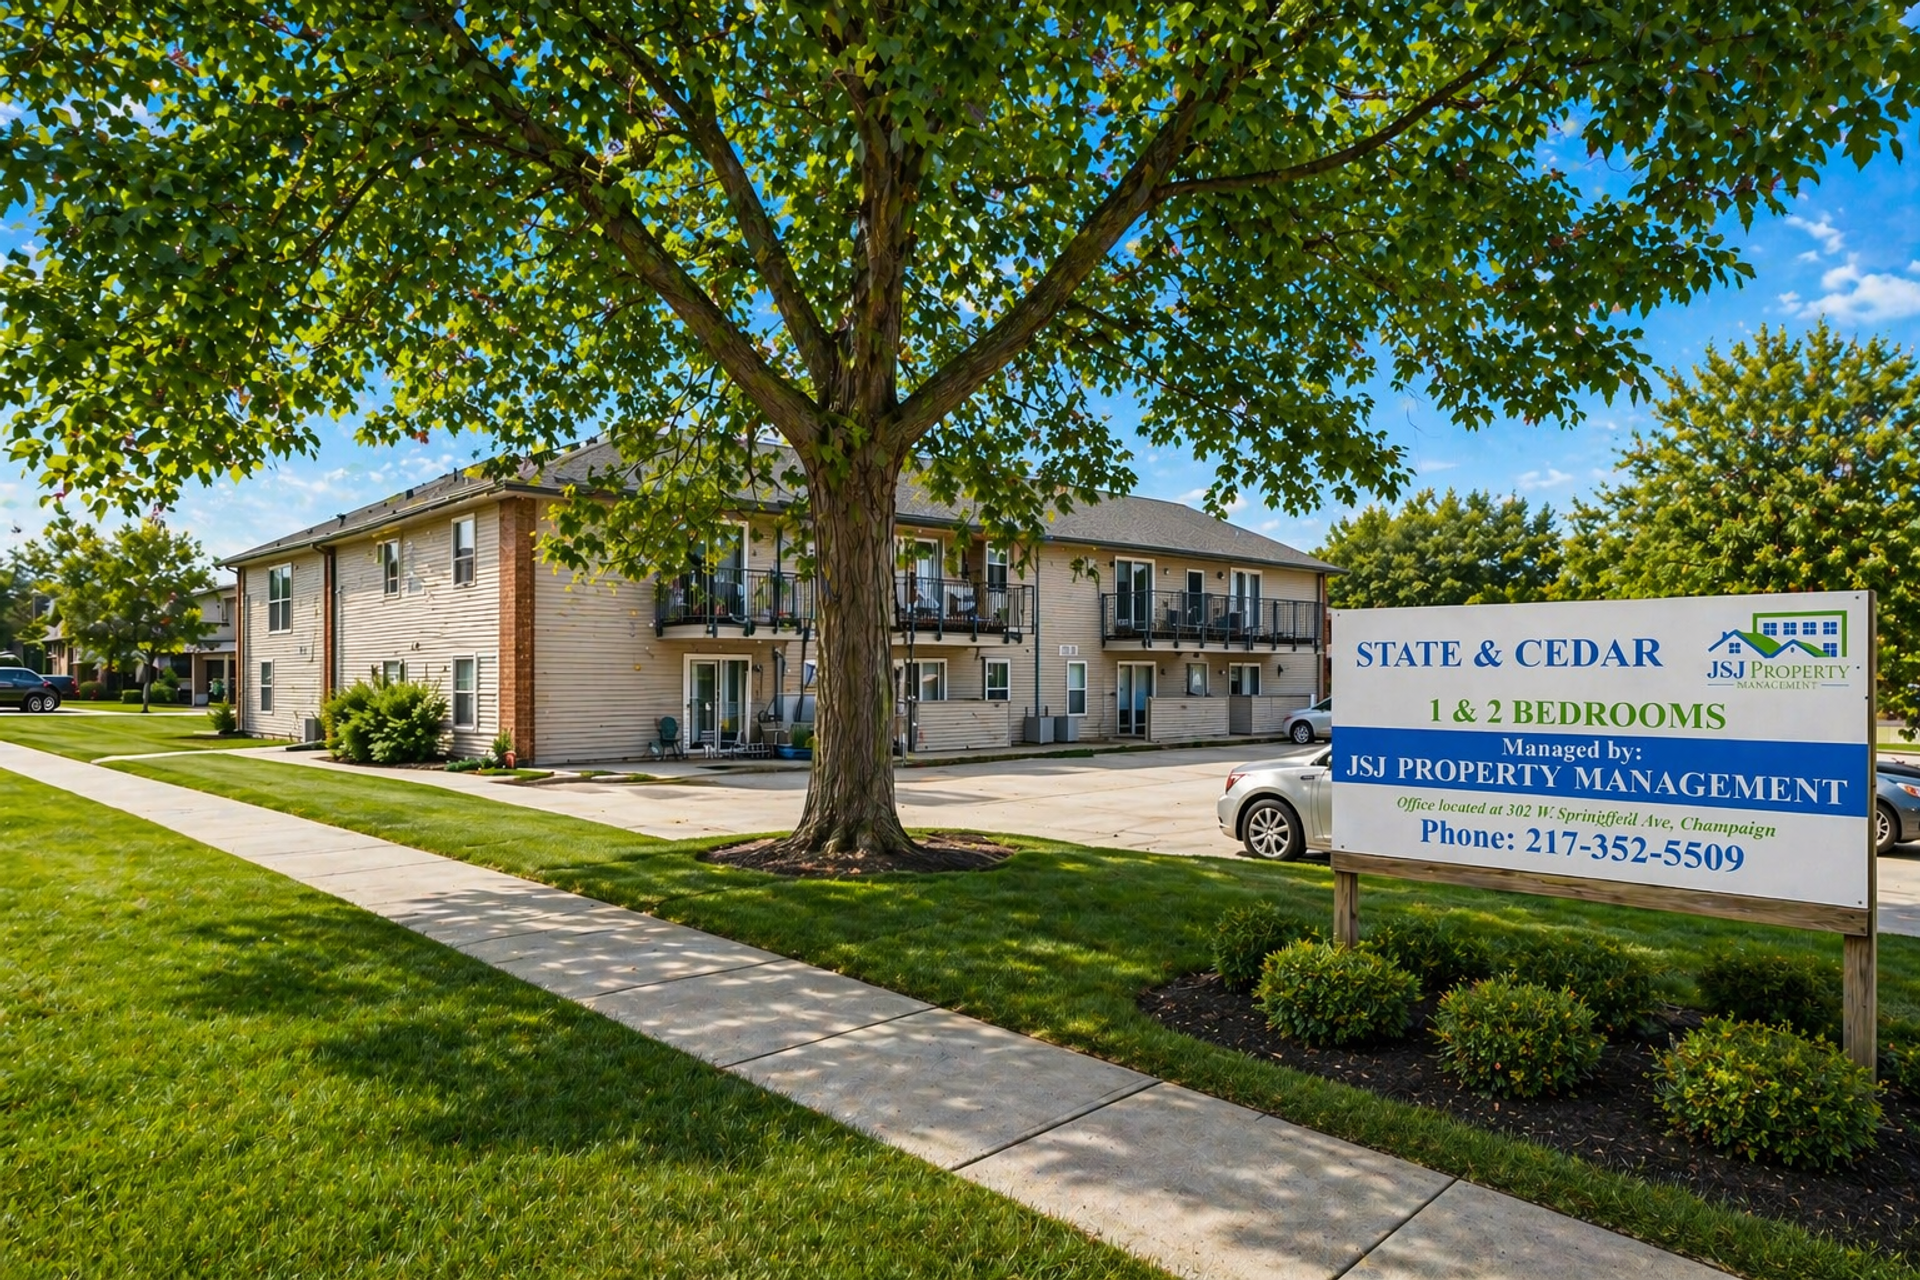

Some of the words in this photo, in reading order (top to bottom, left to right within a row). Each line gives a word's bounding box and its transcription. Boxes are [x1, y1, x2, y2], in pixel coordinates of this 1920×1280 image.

[1356, 640, 1461, 668] STATE
[1474, 640, 1502, 668] &
[1515, 638, 1664, 668] CEDAR
[1707, 661, 1745, 679] JSJ
[1736, 681, 1818, 690] MANAGEMENT
[1430, 699, 1441, 722] 1
[1453, 699, 1477, 723] &
[1486, 699, 1503, 724] 2
[1513, 701, 1727, 730] BEDROOMS
[1502, 737, 1600, 761] Managed
[1607, 739, 1642, 764] by:
[1346, 755, 1387, 779] JSJ
[1397, 757, 1562, 789] PROPERTY
[1574, 766, 1849, 805] MANAGEMENT
[1397, 796, 1435, 812] Office
[1438, 799, 1486, 814] located
[1489, 805, 1503, 815] at
[1506, 804, 1531, 817] 302
[1537, 805, 1555, 819] W.
[1641, 814, 1674, 830] Ave,
[1680, 816, 1776, 839] Champaign
[1420, 818, 1515, 850] Phone:
[1525, 827, 1744, 873] 217-352-5509
